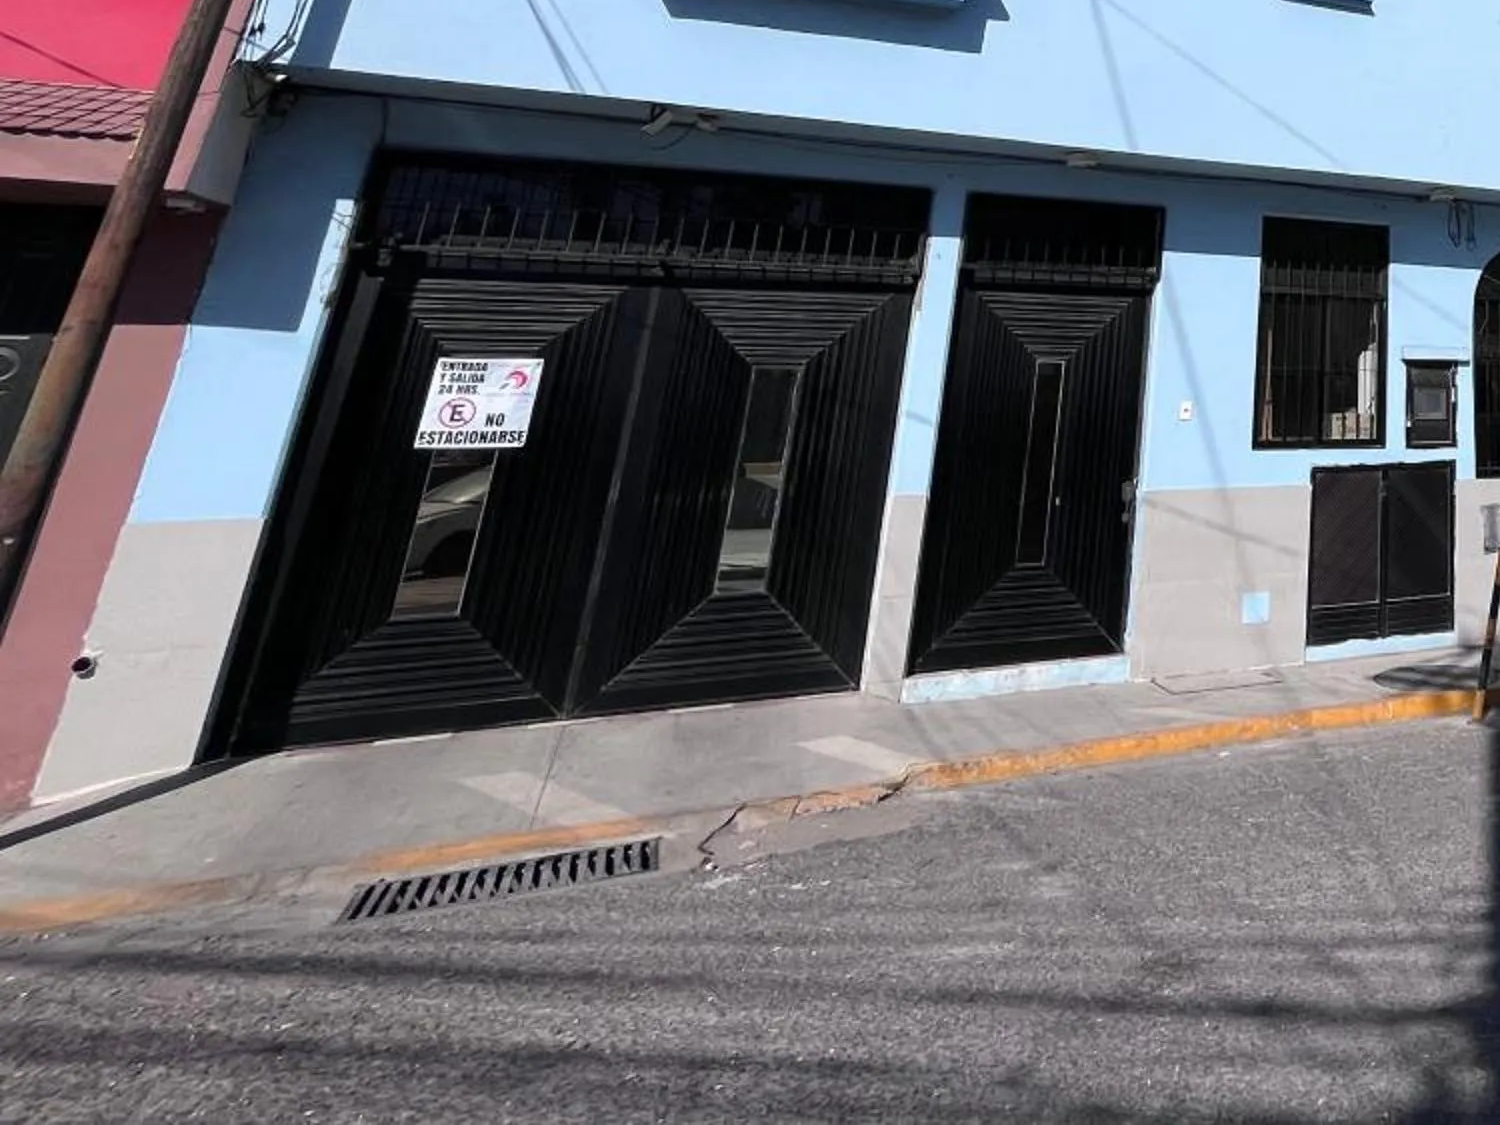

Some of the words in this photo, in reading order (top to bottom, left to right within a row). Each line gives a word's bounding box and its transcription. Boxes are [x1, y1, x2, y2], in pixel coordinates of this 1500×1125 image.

[441, 361, 489, 372] ENTRADA
[439, 374, 446, 383] Y
[448, 373, 486, 384] SALIDA
[449, 404, 466, 422] E
[485, 413, 505, 427] NO
[418, 430, 527, 446] ESTACIONARSE
